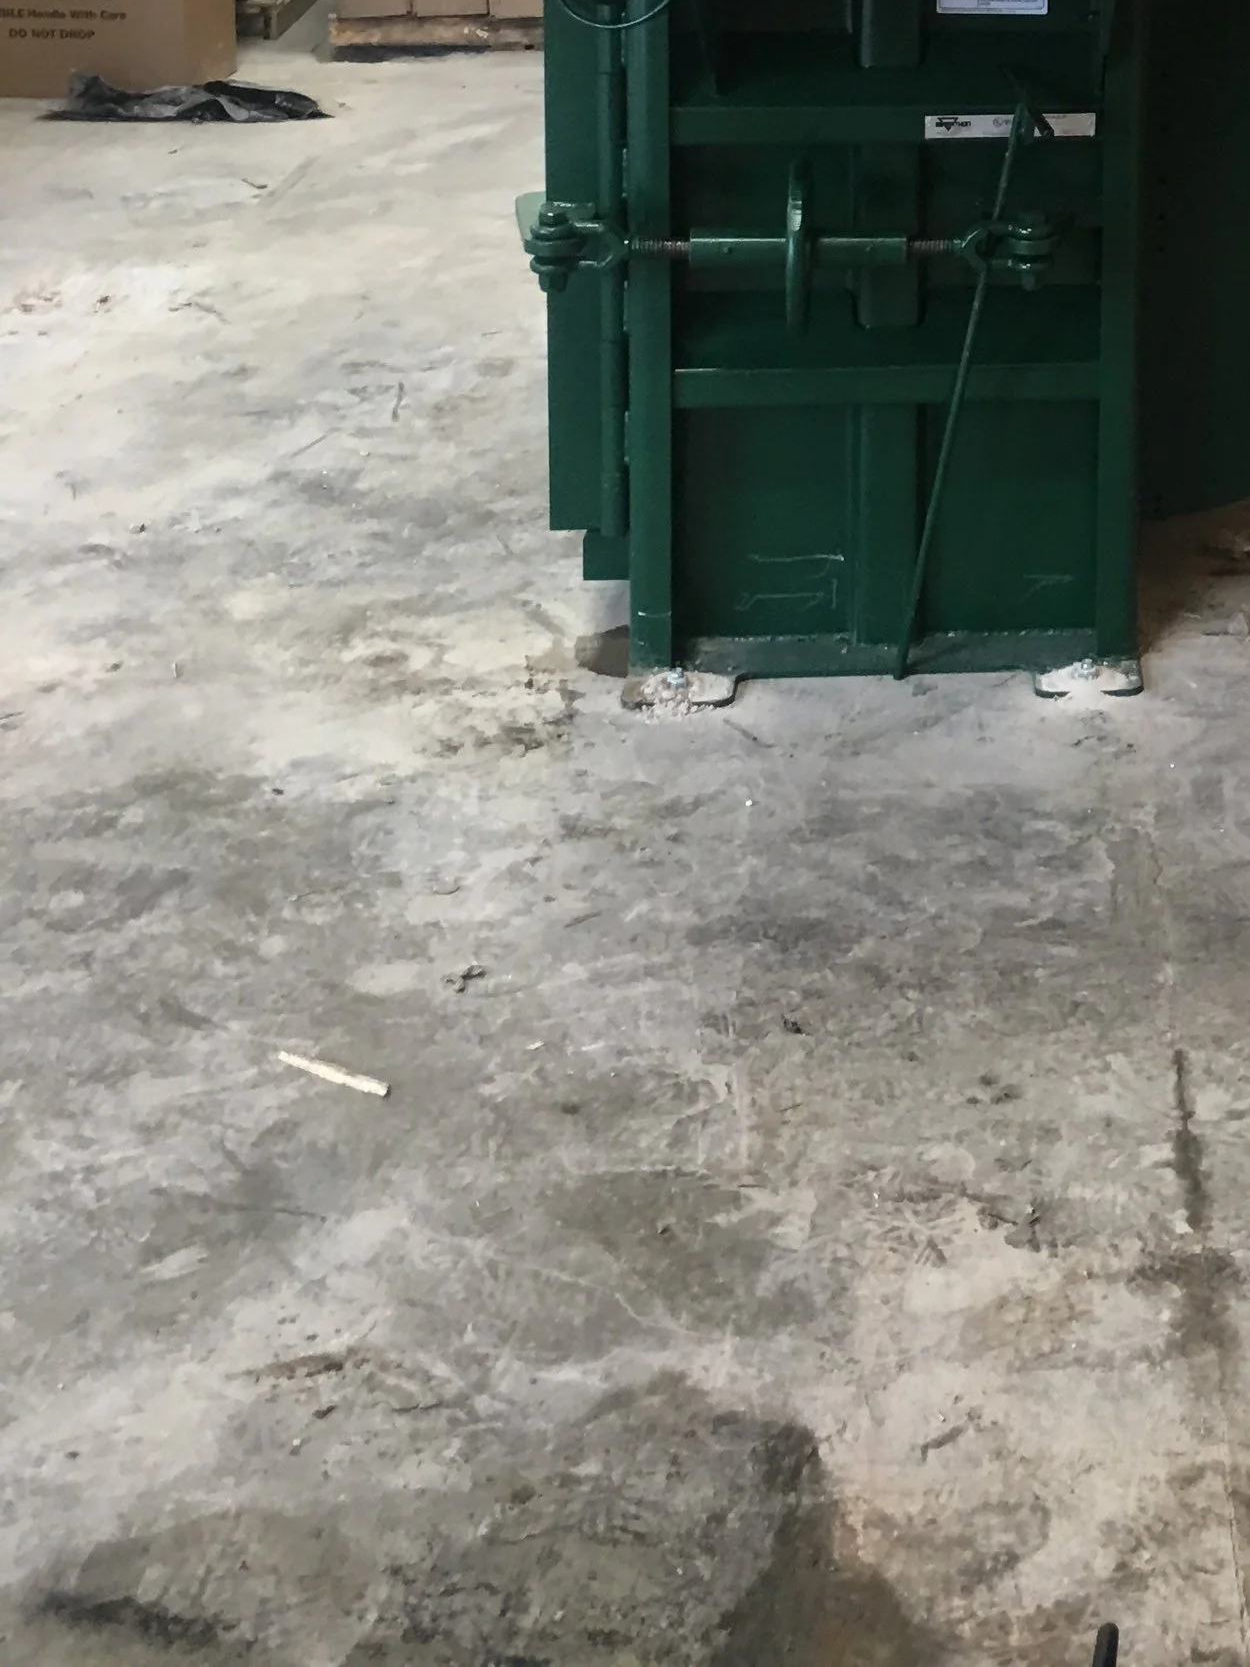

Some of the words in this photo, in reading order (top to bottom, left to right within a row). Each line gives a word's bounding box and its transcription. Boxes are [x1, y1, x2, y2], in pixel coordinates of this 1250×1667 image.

[100, 10, 127, 21] Care
[8, 28, 28, 39] DO
[31, 28, 56, 39] NOT
[60, 29, 96, 40] DROP
